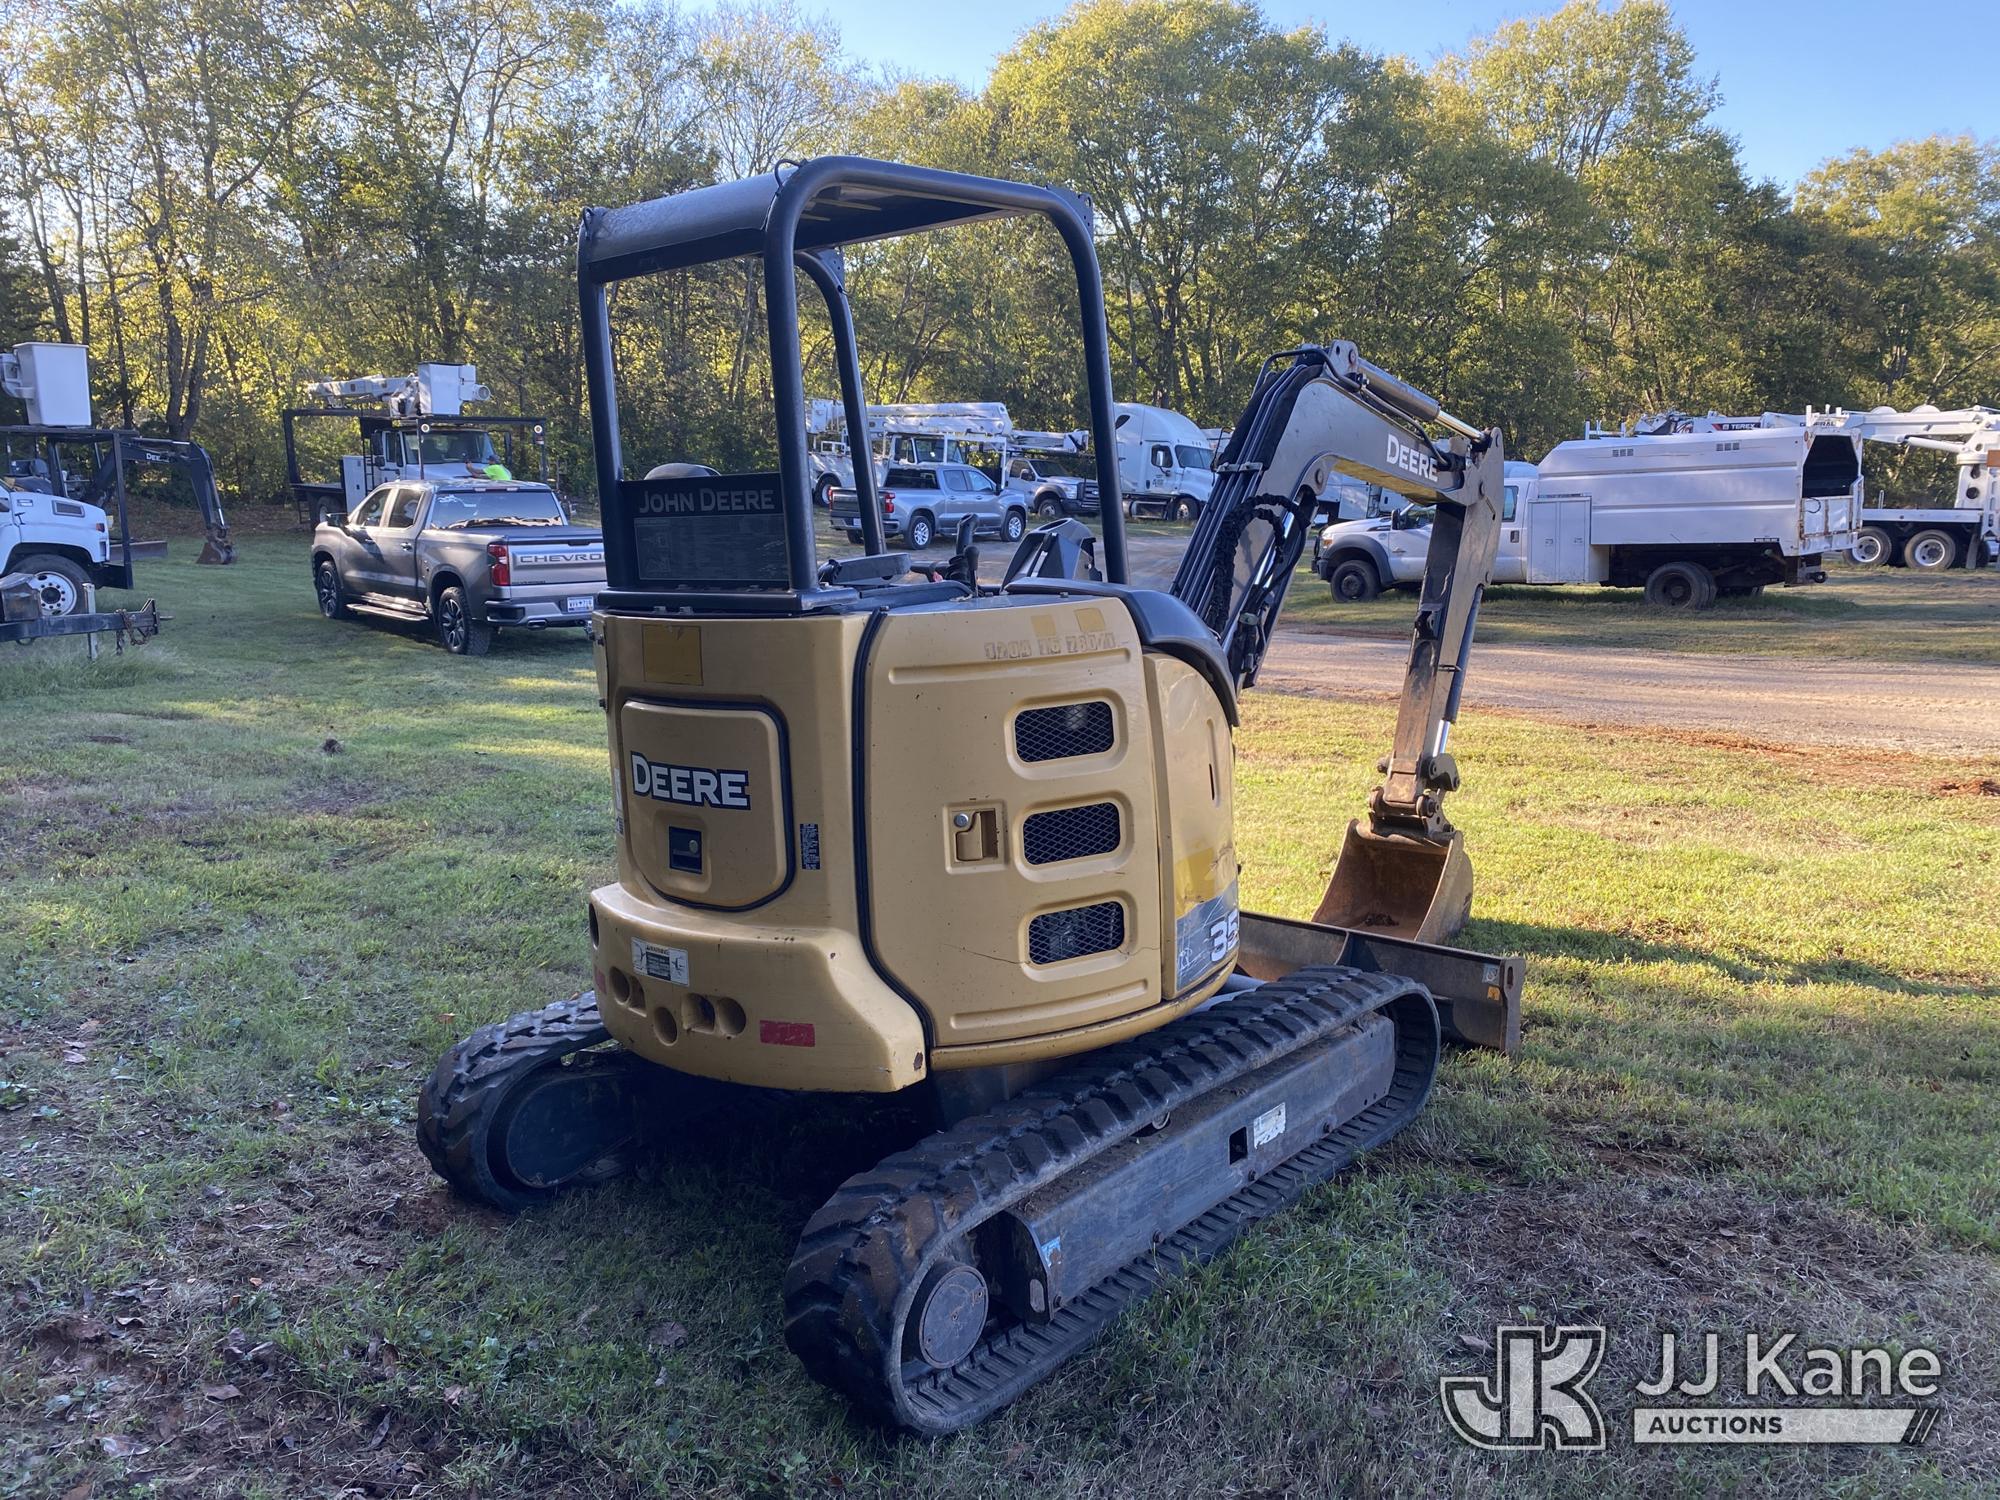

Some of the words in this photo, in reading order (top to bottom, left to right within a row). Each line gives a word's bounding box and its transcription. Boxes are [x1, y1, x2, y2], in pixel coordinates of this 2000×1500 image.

[1386, 433, 1439, 482] DEERE
[639, 490, 694, 513] JOHN
[698, 487, 775, 512] DEERE
[630, 753, 749, 808] DEERE
